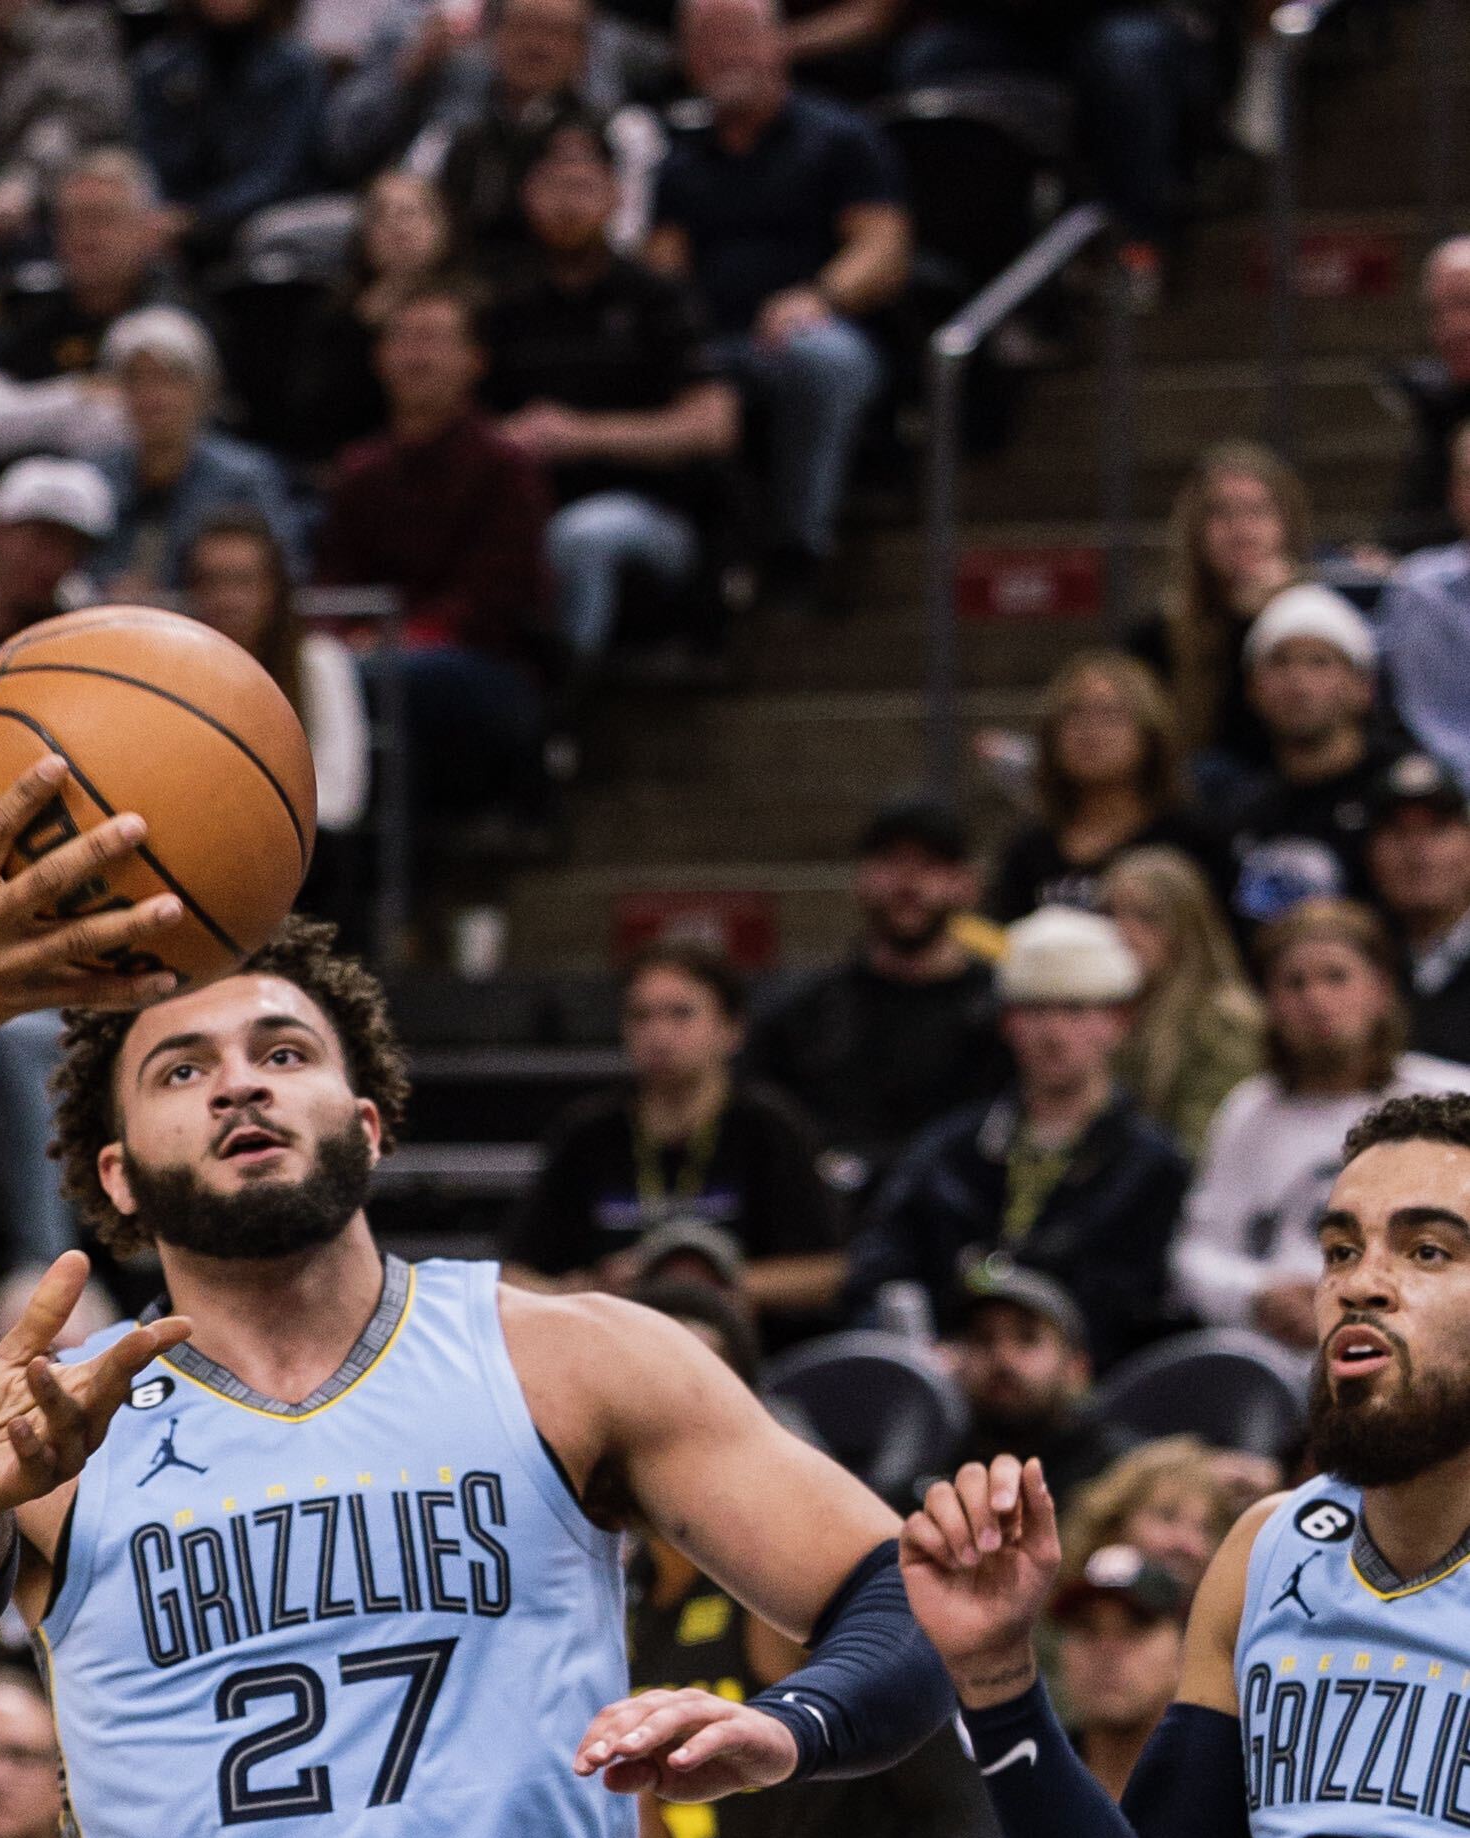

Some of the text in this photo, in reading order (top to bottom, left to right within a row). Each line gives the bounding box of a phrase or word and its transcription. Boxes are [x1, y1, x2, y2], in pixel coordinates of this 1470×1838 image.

[131, 1381, 165, 1409] 6
[130, 1470, 513, 1669] GRIZZLIES
[1300, 1504, 1348, 1540] 6
[1278, 1652, 1470, 1690] MEMPHI
[214, 1636, 461, 1827] 27
[1244, 1662, 1470, 1829] GRIZZLIE
